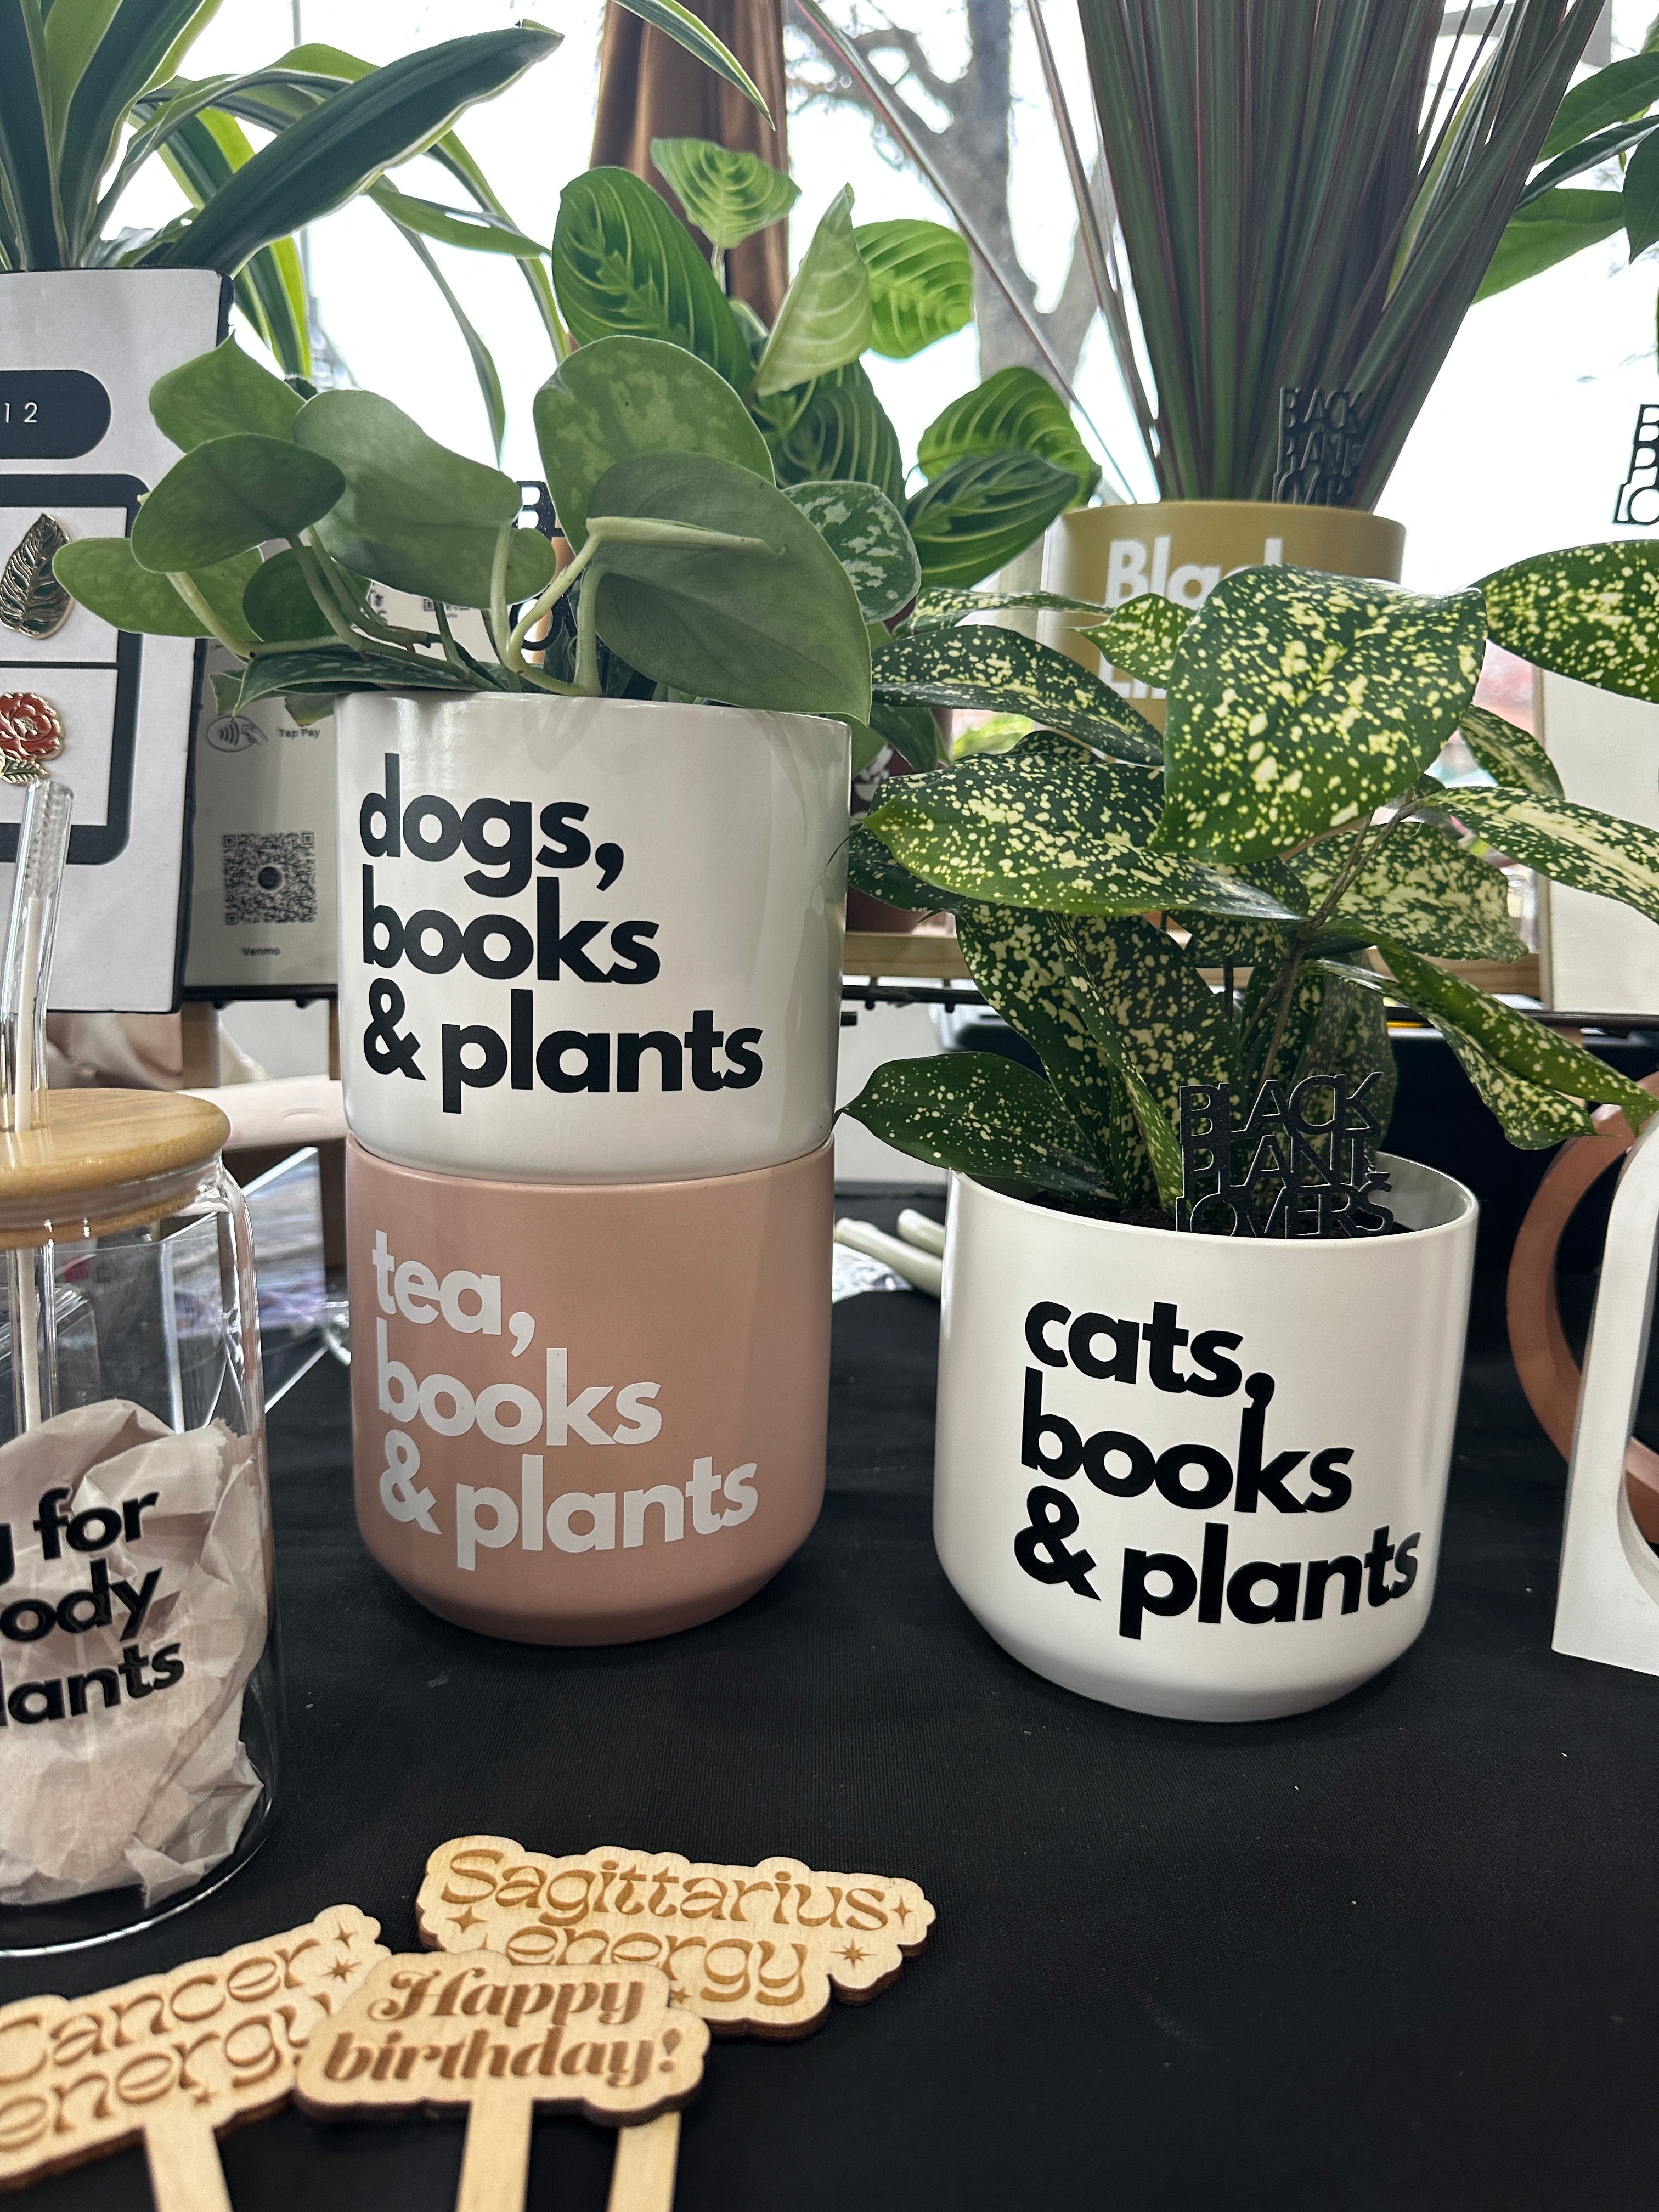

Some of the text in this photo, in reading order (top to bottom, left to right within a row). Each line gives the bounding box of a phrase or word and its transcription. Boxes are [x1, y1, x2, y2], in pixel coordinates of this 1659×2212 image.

[1104, 536, 1284, 611] Bla
[277, 727, 320, 739] Tap Pay
[359, 753, 624, 898] dogs,
[242, 947, 281, 956] Venmo
[362, 864, 661, 985] books
[363, 978, 763, 1114] & plants
[1179, 1071, 1384, 1141] BLACK
[1182, 1131, 1381, 1197] PLANT
[1176, 1182, 1394, 1239] LOVERS
[373, 1229, 536, 1358] tea,
[376, 1316, 662, 1446] books
[1025, 1301, 1276, 1409] cats,
[1021, 1365, 1355, 1514] books
[33, 1486, 160, 1561] for
[380, 1429, 759, 1572] & plants
[1014, 1485, 1421, 1640] & plants
[439, 1847, 890, 1932] Sagittarius
[367, 1966, 645, 2027] Happy
[505, 1925, 808, 2006] energy
[0, 1938, 321, 2084] Cancer
[323, 2025, 683, 2088] birthday!
